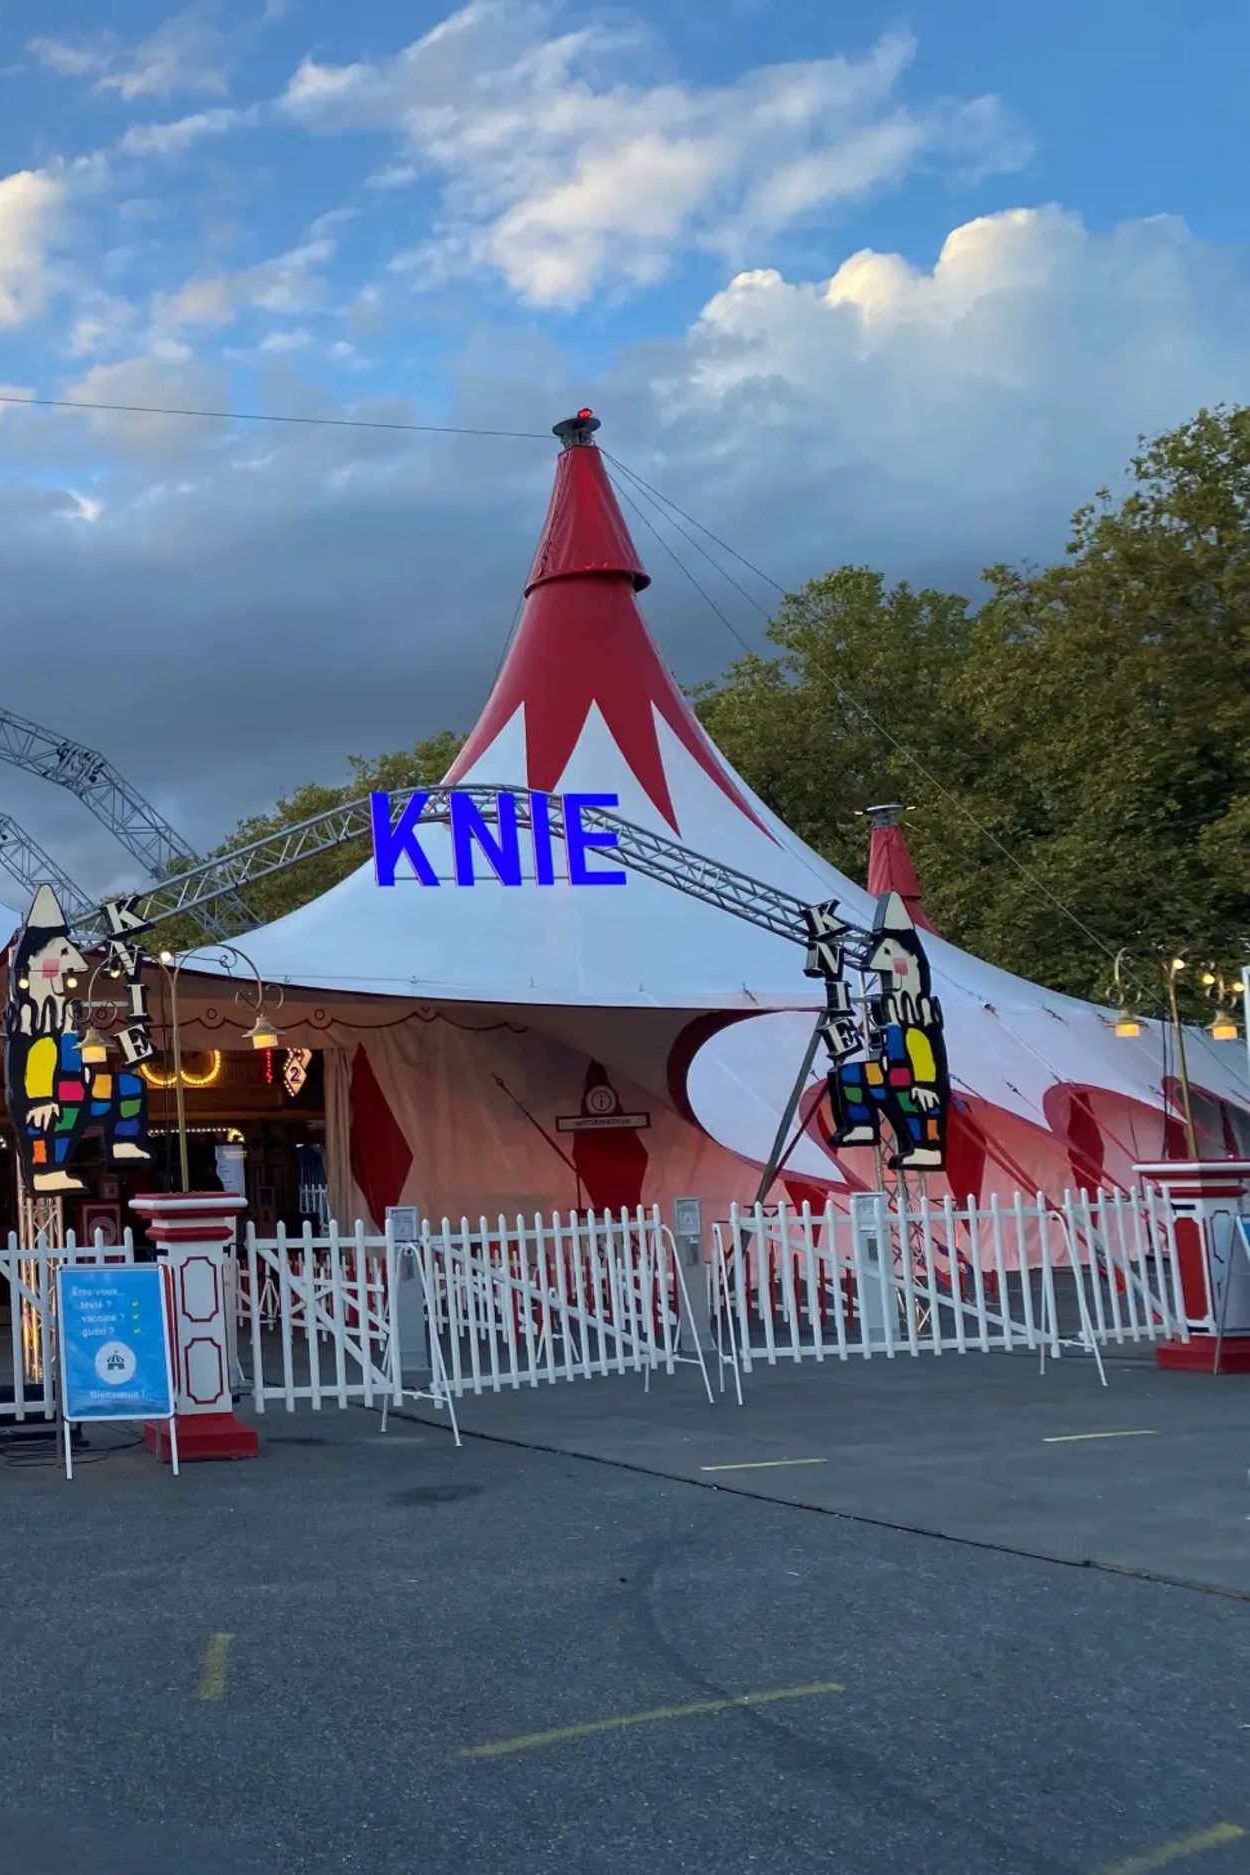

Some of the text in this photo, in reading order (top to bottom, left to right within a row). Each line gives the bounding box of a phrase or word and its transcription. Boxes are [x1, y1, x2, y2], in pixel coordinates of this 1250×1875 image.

[369, 792, 627, 886] KNIE
[101, 896, 155, 1066] KNIE
[805, 899, 861, 1060] KNIE
